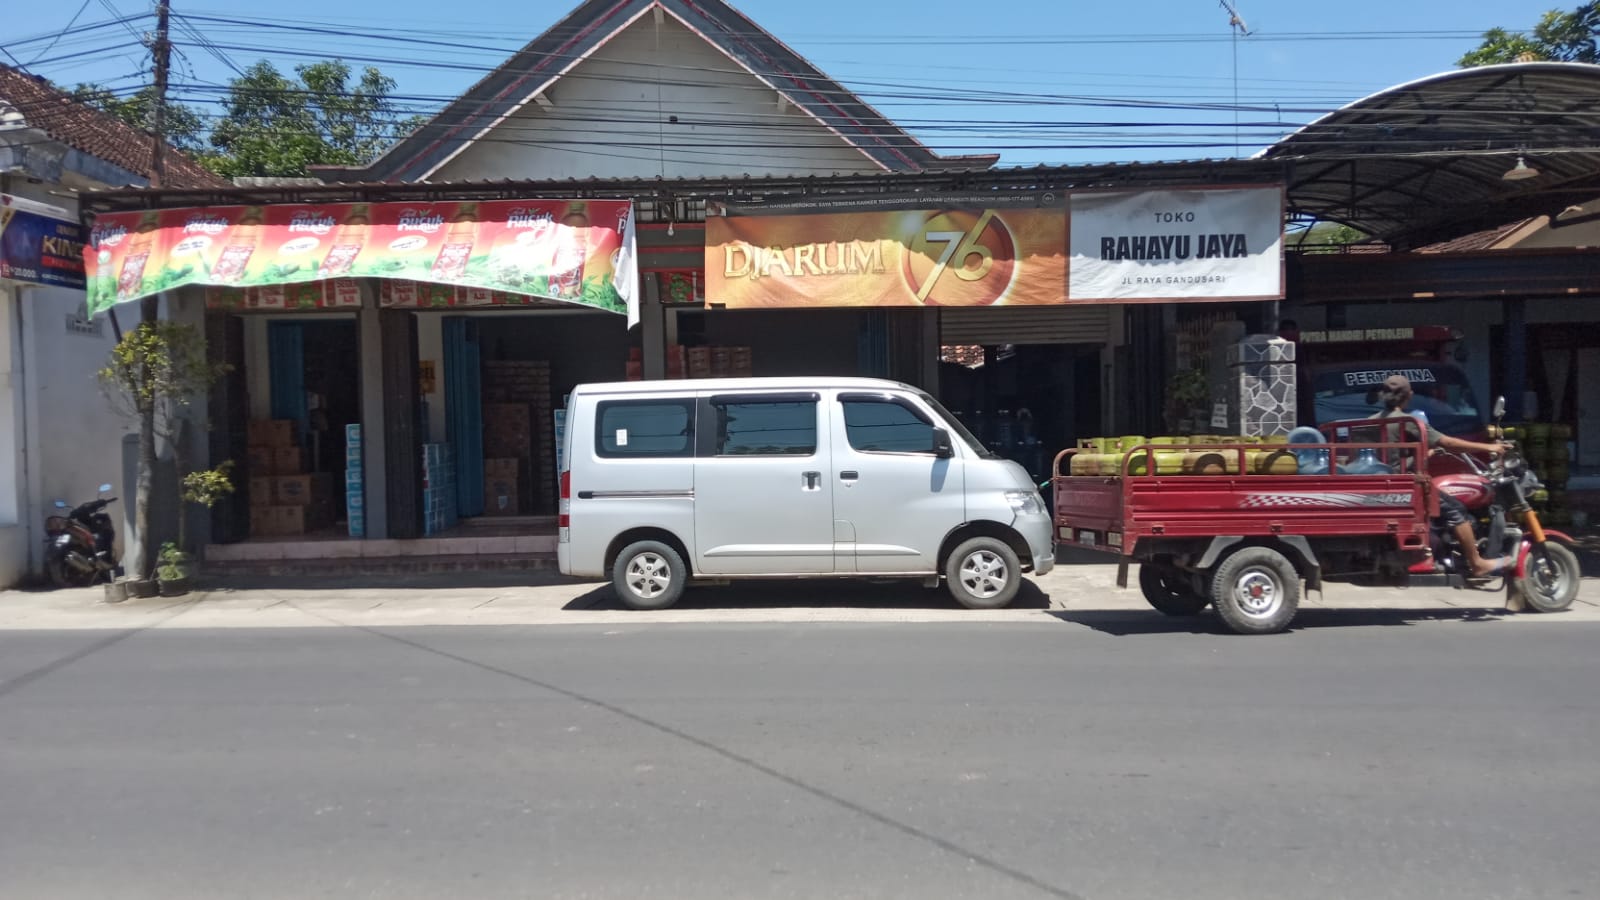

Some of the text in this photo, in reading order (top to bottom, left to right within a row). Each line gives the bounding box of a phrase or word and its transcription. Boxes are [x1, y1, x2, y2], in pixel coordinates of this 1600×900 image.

[1154, 212, 1195, 223] TOKO
[723, 242, 885, 280] DJARUM
[917, 209, 997, 303] 76
[1100, 233, 1248, 261] RAHAYU JAYA
[1121, 275, 1226, 286] JL RAYA GANDUSARI
